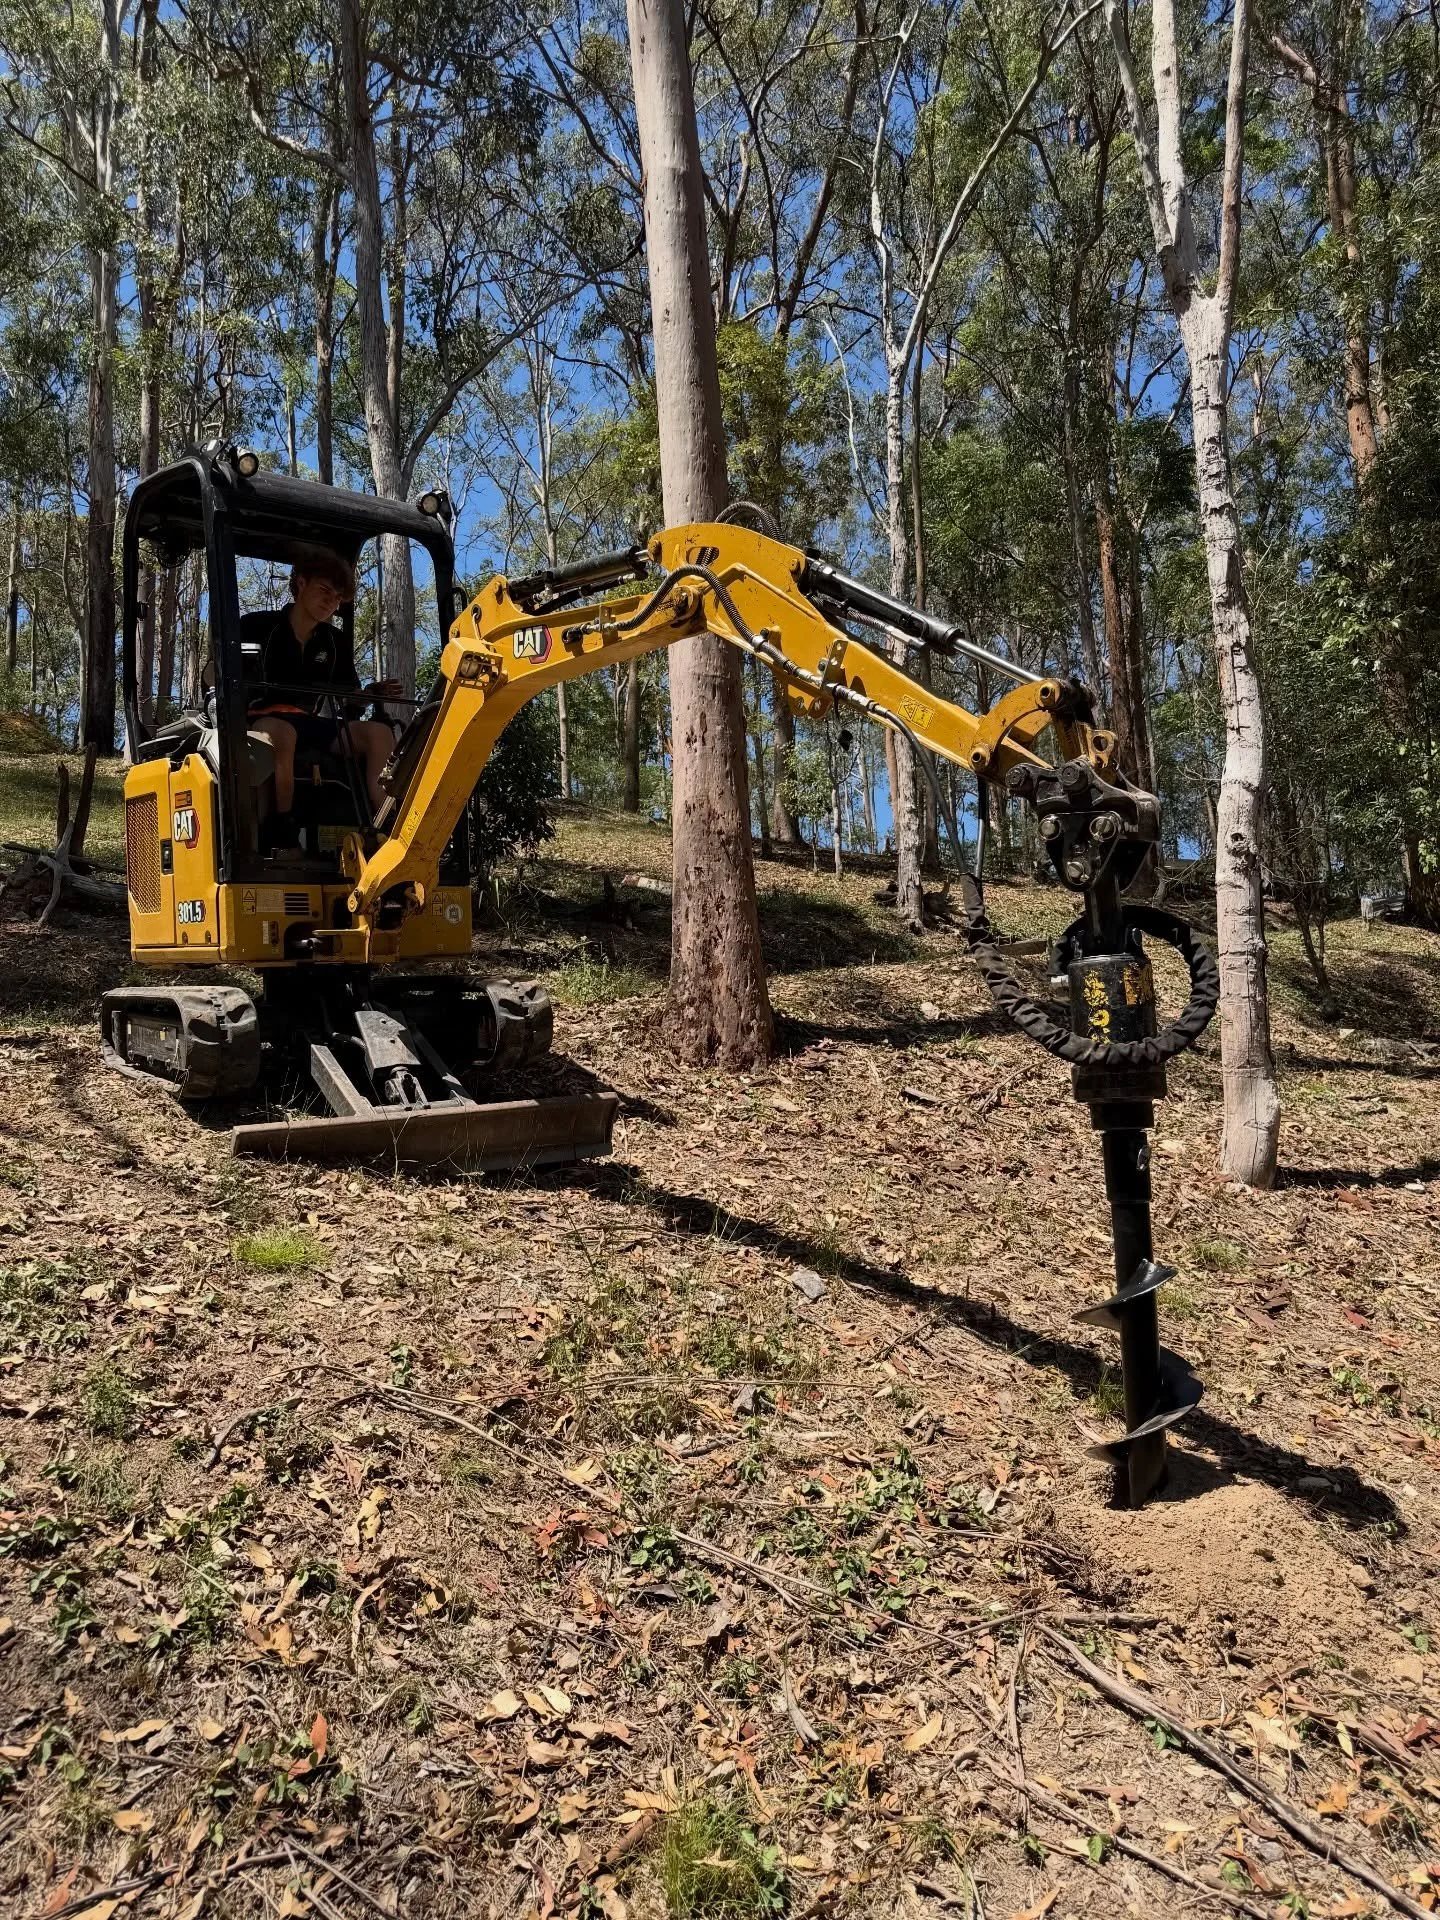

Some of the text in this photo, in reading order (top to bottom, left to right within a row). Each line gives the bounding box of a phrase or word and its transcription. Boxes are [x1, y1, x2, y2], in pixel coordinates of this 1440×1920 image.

[513, 625, 543, 658] CAT
[173, 809, 193, 841] CAT
[178, 901, 201, 923] 301.5
